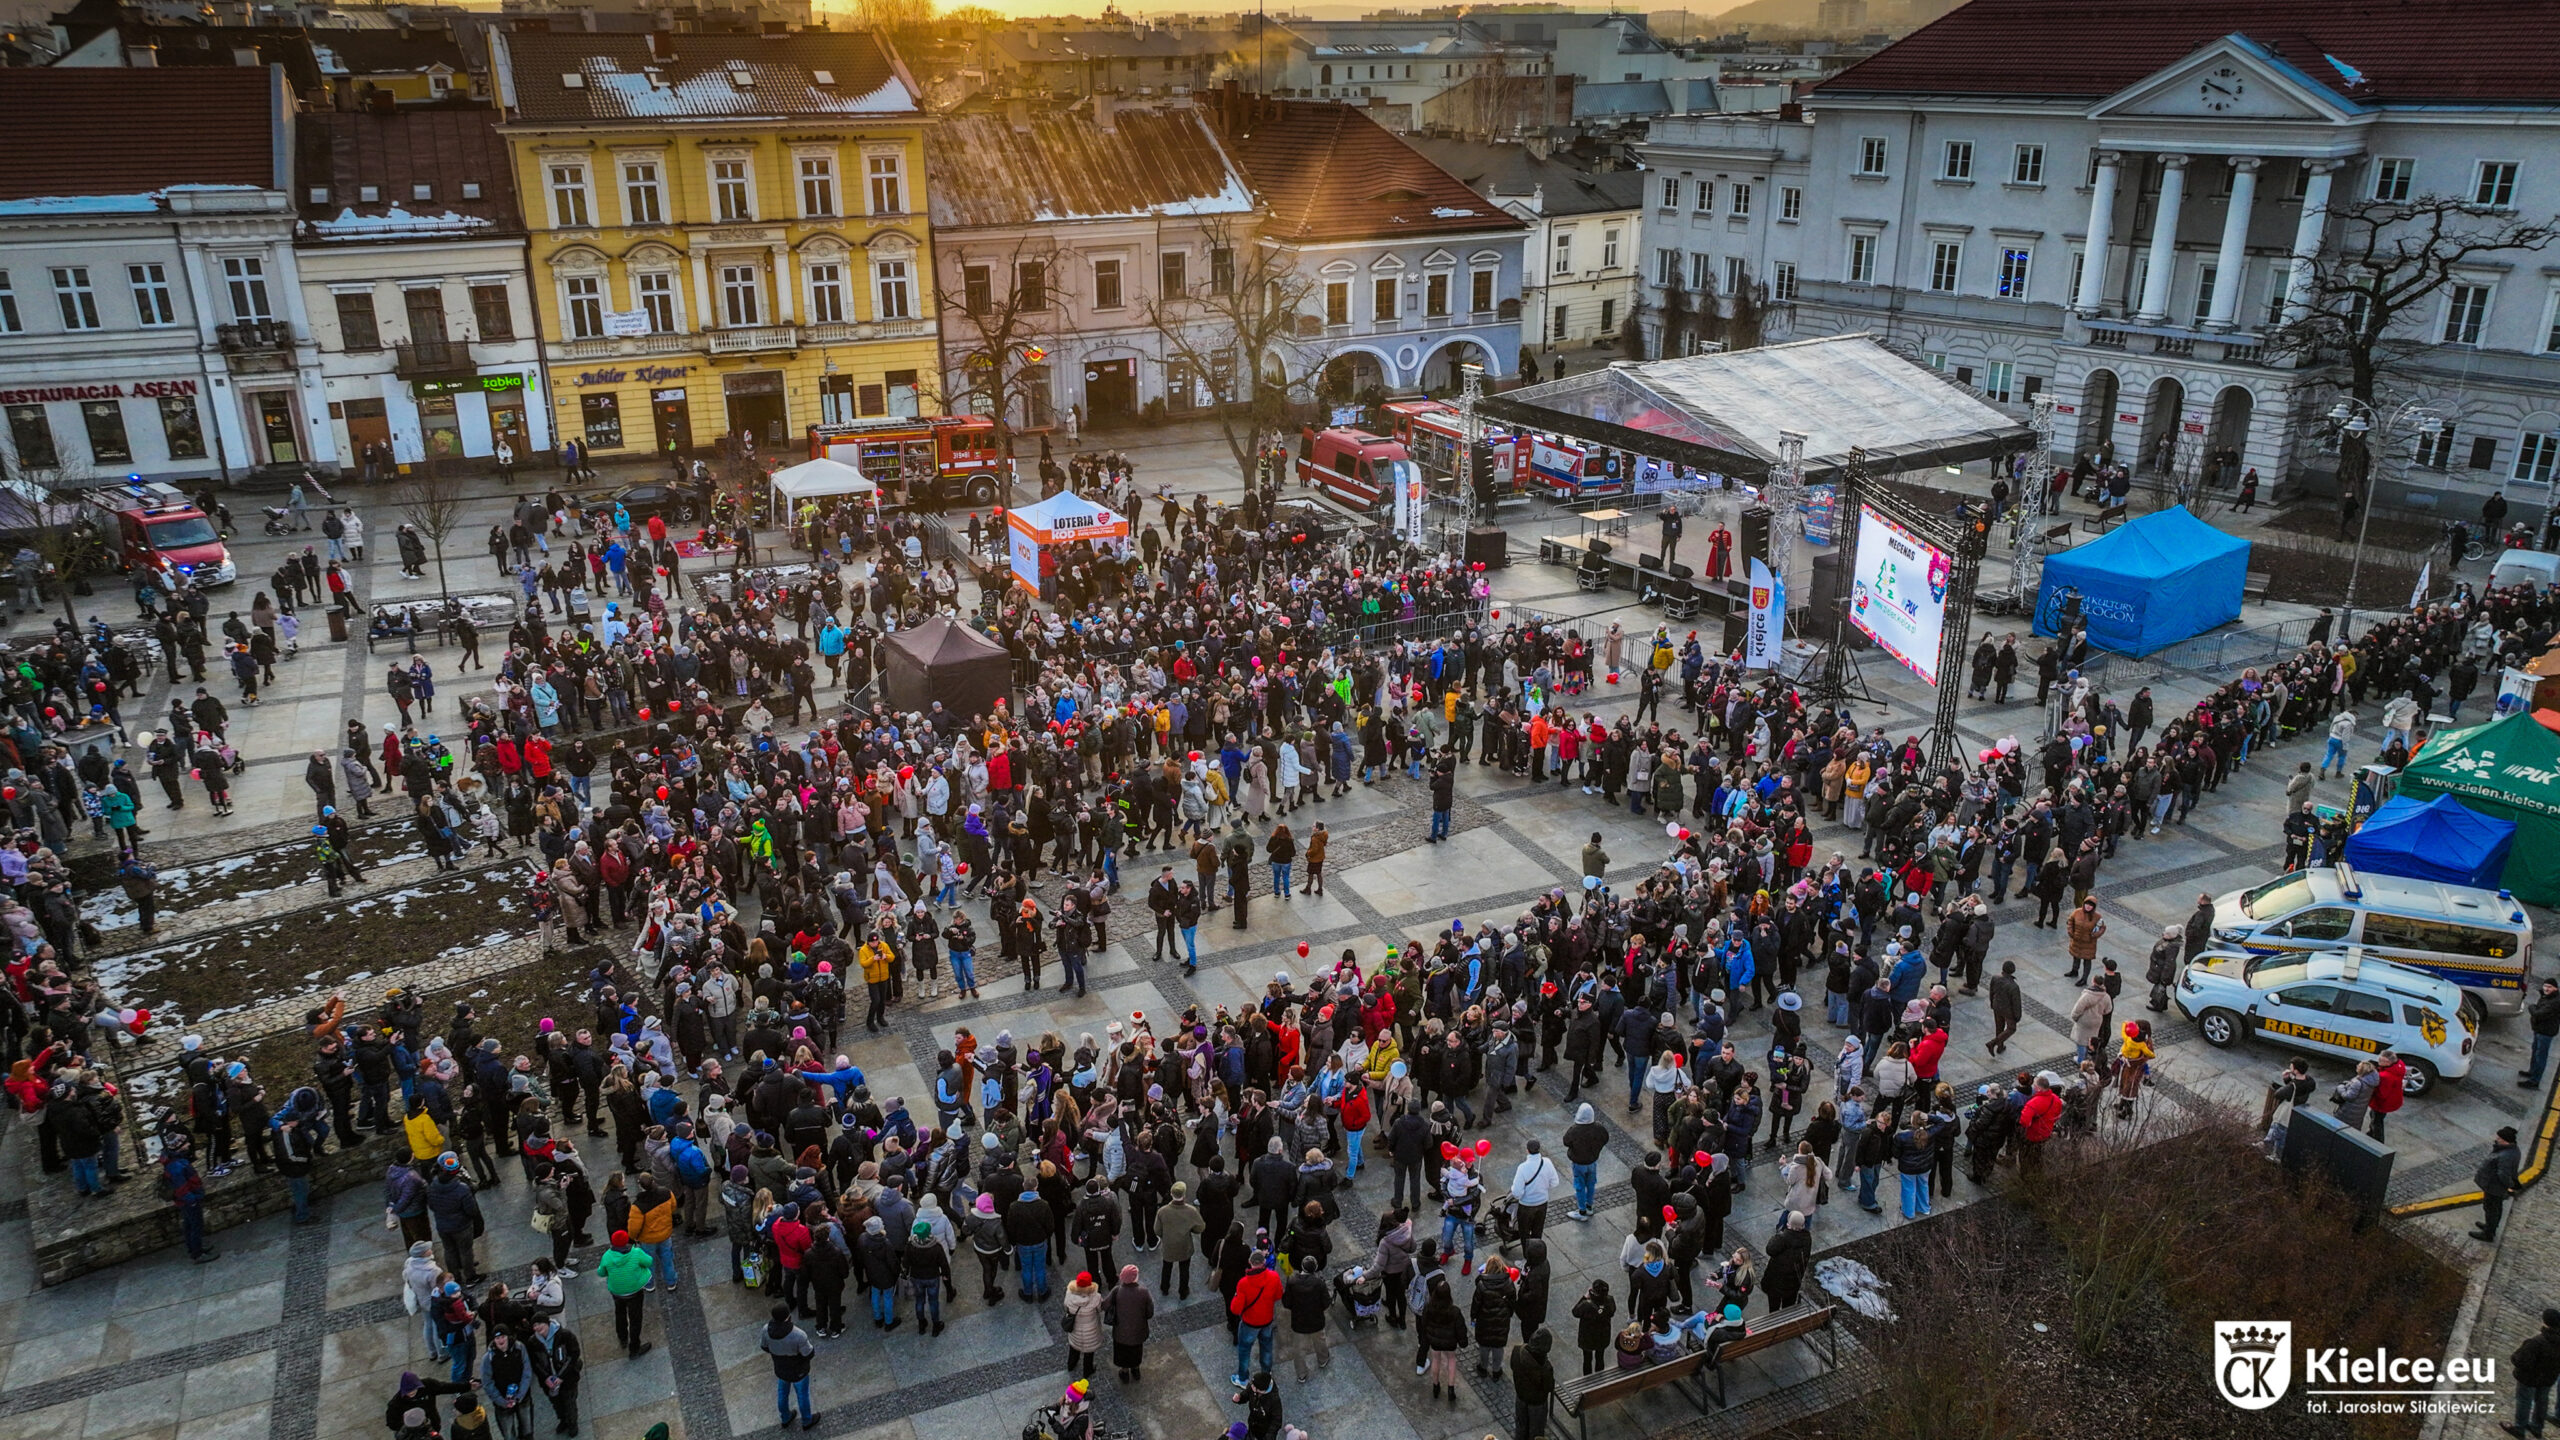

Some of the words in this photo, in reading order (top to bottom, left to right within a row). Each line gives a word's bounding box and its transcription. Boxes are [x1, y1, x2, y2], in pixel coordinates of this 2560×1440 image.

[483, 376, 521, 388] żabka
[578, 367, 626, 387] Jubiler
[635, 365, 687, 384] Klejnot
[0, 384, 124, 404] RESTAURACJA
[132, 380, 198, 398] ASEAN
[1053, 515, 1094, 529] LOTERIA
[1052, 529, 1076, 540] KOD
[1888, 537, 1916, 561] MECENAS
[2092, 596, 2135, 612] KULTURY
[2514, 766, 2559, 785] PUK
[2489, 948, 2503, 957] 12
[2502, 980, 2518, 988] 986
[2264, 1018, 2377, 1053] RAF-GUARD
